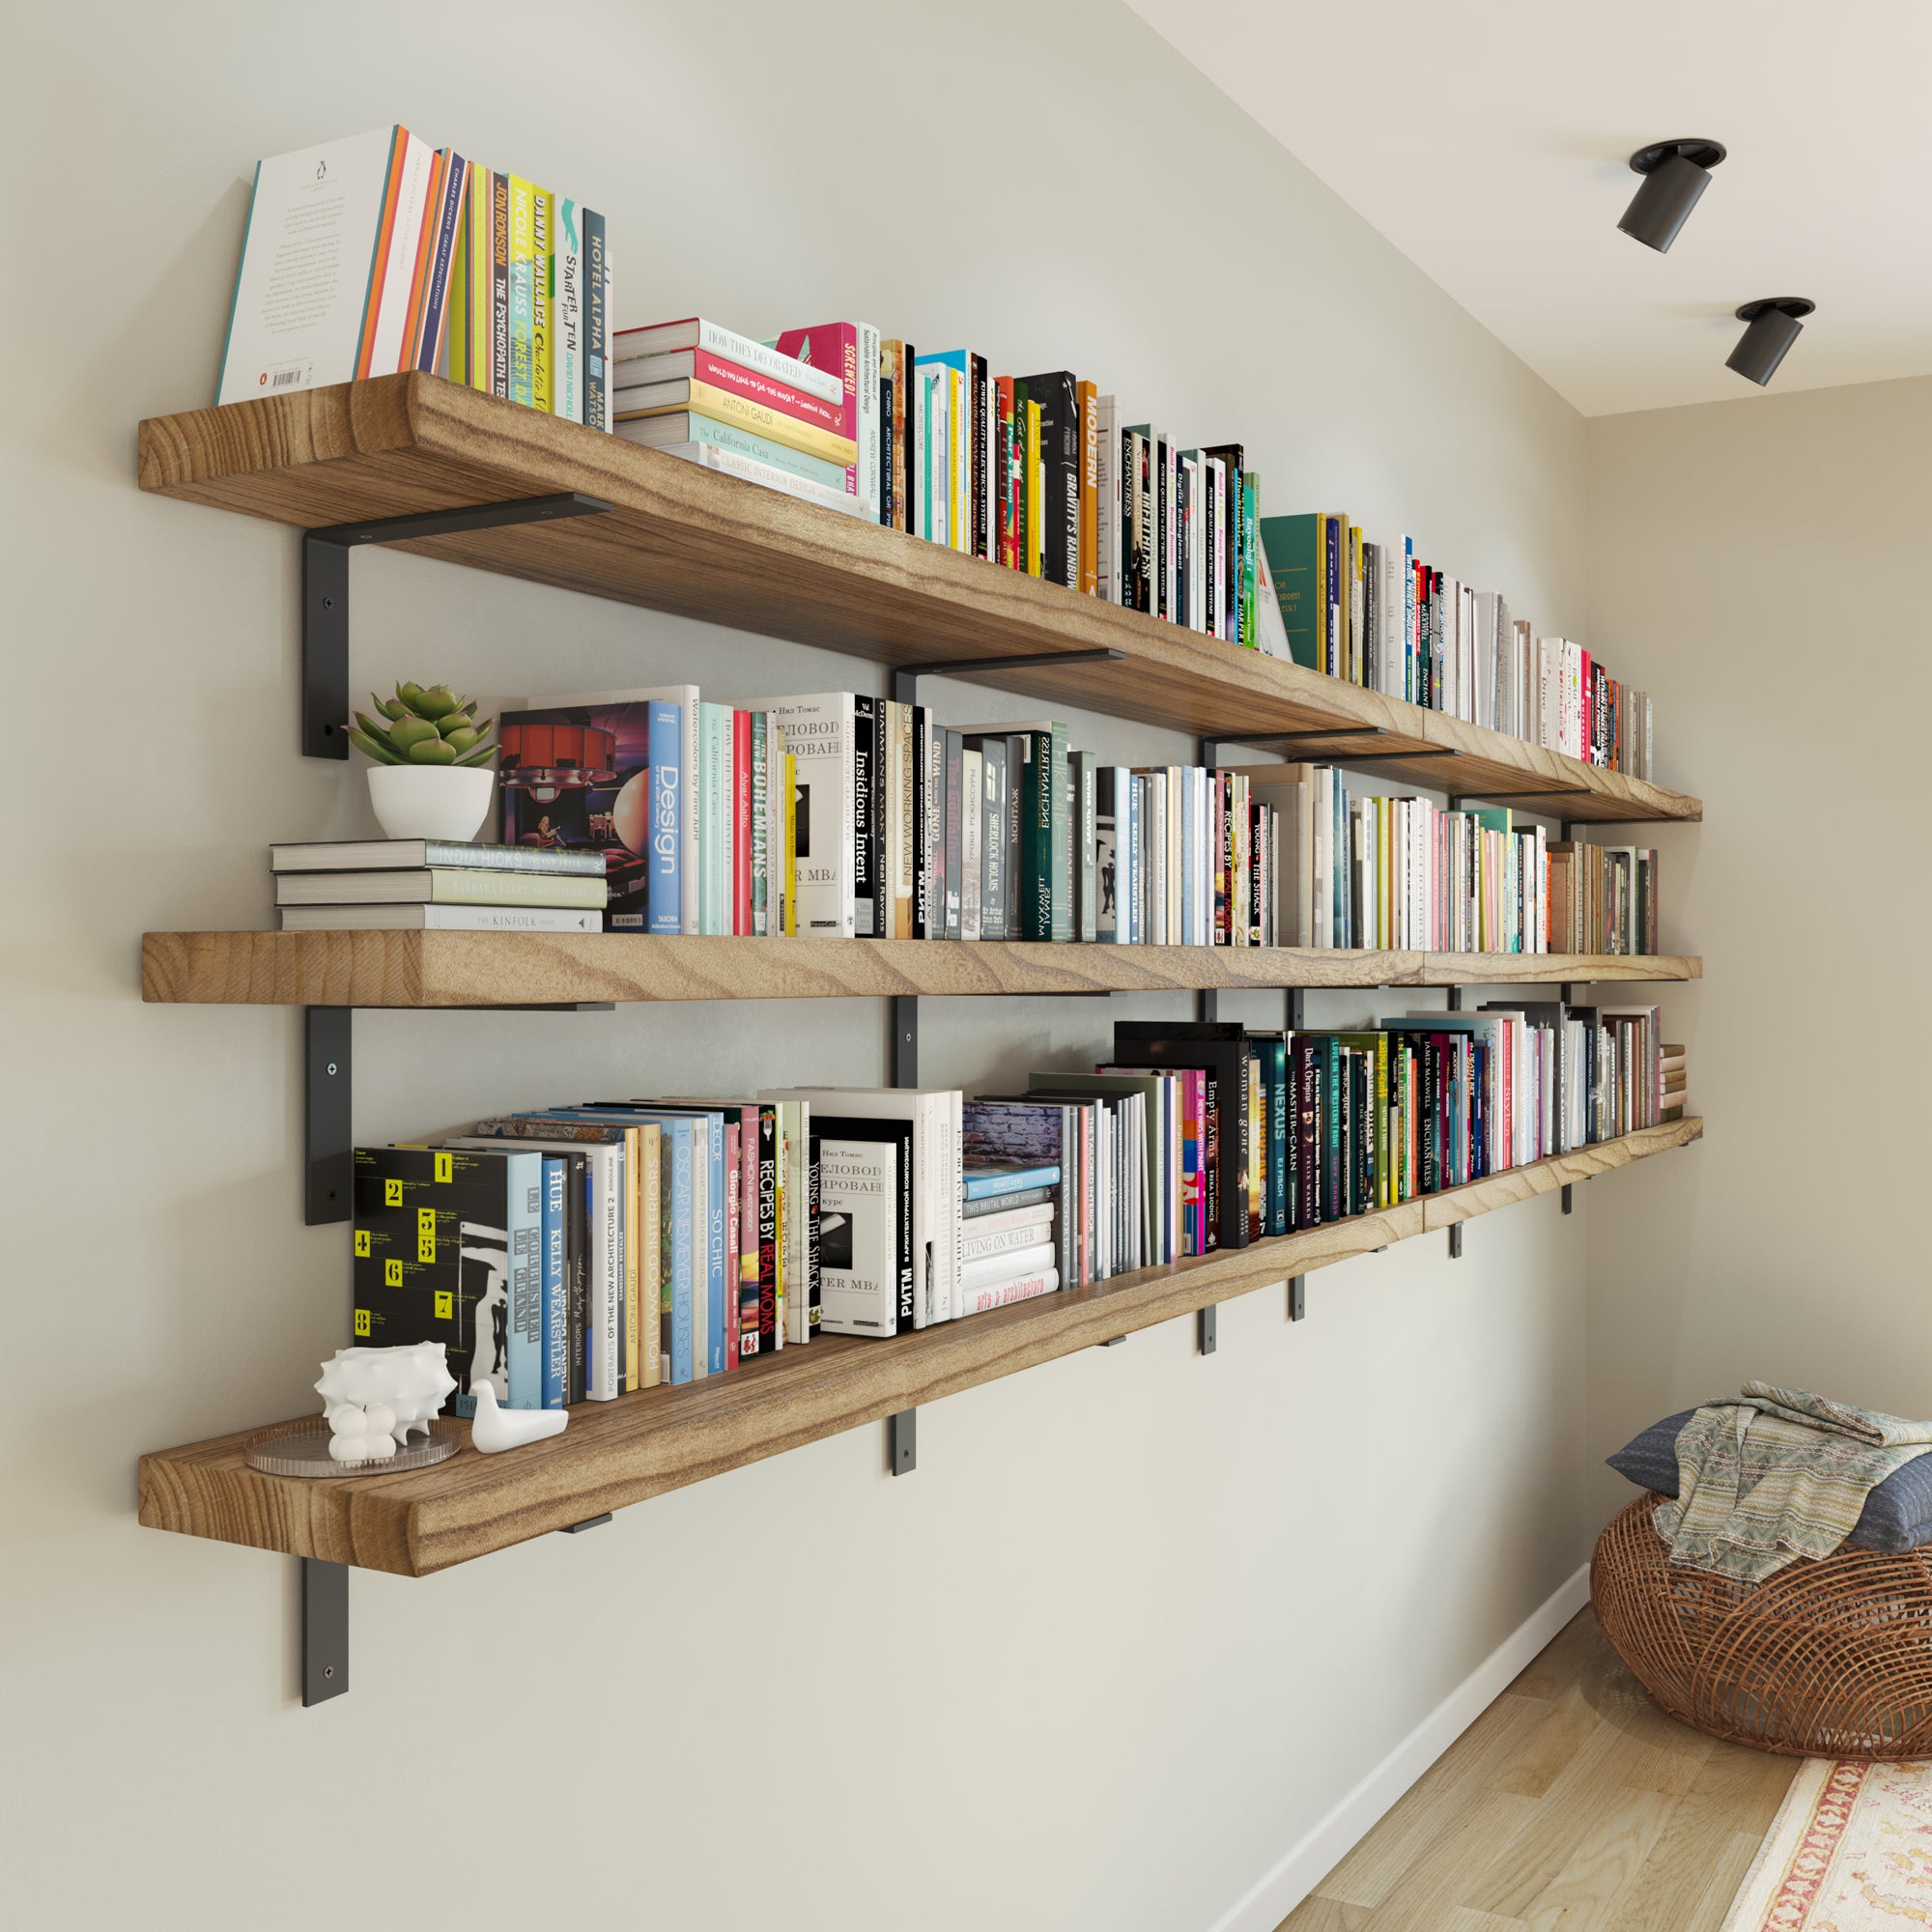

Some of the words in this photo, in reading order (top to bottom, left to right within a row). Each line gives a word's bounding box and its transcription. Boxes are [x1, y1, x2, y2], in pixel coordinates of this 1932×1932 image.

[451, 167, 460, 198] CHARLES
[495, 182, 507, 211] JON
[445, 199, 456, 230] DICKENS
[515, 188, 526, 247] NICOLE
[533, 195, 546, 251] DANNY
[440, 233, 449, 258] GREAT
[495, 211, 507, 267] RONSON
[592, 236, 602, 288] HOTEL
[433, 258, 444, 310] EXPECTATIONS
[497, 278, 507, 300] THE
[515, 251, 526, 317] KRAUSS
[533, 254, 546, 328] WALLACE
[564, 255, 578, 313] STARTER
[497, 301, 507, 379] PSYCHOPATH
[564, 322, 577, 351] TEN
[592, 294, 602, 350] ALPHA
[515, 320, 526, 382] FOREST
[533, 332, 546, 390] Charlotte
[708, 329, 727, 348] HOW
[730, 338, 752, 360] THEY
[753, 347, 802, 379] DECORATED
[723, 397, 749, 416] ANTONI
[713, 428, 751, 455] California
[752, 444, 769, 460] Casa
[1088, 396, 1097, 489] MODERN
[722, 454, 753, 475] CLASSIC
[753, 463, 789, 485] INTERIOR
[789, 474, 816, 496] DESIGN
[1066, 473, 1077, 534] GRAVITY'S
[1066, 535, 1077, 590] RAINBOW
[903, 705, 912, 762] SPACES
[692, 777, 699, 786] by
[856, 751, 868, 828] Insidious
[947, 759, 958, 785] The
[655, 766, 679, 874] Design
[754, 763, 766, 878] BOHEMIANS
[903, 768, 912, 838] WORKING
[1010, 788, 1019, 844] МОНТАЖ
[947, 790, 958, 866] Godfather
[989, 813, 999, 859] SHERLOCK
[440, 848, 476, 864] INDIA
[483, 851, 522, 867] HICKS
[856, 833, 868, 883] Intent
[903, 842, 912, 876] NEW
[989, 862, 999, 892] HOLMS
[1225, 855, 1232, 868] BY
[493, 916, 537, 927] KINFOLK
[1302, 1047, 1314, 1068] Dark
[1378, 1039, 1387, 1070] Potter
[1207, 1082, 1216, 1121] Empty
[1302, 1071, 1314, 1103] Origins
[1275, 1083, 1285, 1140] NEXUS
[713, 1123, 723, 1162] DECOR
[1238, 1119, 1248, 1154] gone
[440, 1158, 447, 1178] 1
[676, 1146, 690, 1207] OSCAR
[809, 1162, 820, 1205] YOUNG
[1277, 1157, 1284, 1168] EJ
[388, 1183, 399, 1201] 2
[528, 1188, 539, 1213] LE
[551, 1169, 562, 1212] HUE
[647, 1159, 659, 1250] INTERIORS
[728, 1170, 738, 1214] Giorgio
[760, 1161, 773, 1217] RECIPES
[967, 1202, 980, 1214] THIS
[980, 1199, 999, 1211] BRUTAL
[1000, 1194, 1019, 1208] WORLD
[421, 1211, 432, 1231] 3
[712, 1209, 723, 1233] SO
[728, 1218, 738, 1254] Casali
[760, 1222, 773, 1239] BY
[809, 1217, 820, 1242] THE
[357, 1233, 368, 1253] 4
[421, 1238, 433, 1258] 5
[514, 1230, 526, 1255] LE
[551, 1230, 562, 1278] KELLY
[676, 1208, 690, 1290] NIEMEYER
[712, 1236, 723, 1278] CHIC
[760, 1244, 773, 1283] REAL
[962, 1239, 993, 1257] LIVING
[995, 1236, 1006, 1250] ON
[1008, 1229, 1035, 1247] WATER
[388, 1262, 400, 1282] 6
[528, 1227, 539, 1343] CORBUSIER
[809, 1246, 820, 1289] SHACK
[439, 1294, 449, 1314] 7
[514, 1267, 526, 1333] GRAND
[647, 1256, 659, 1370] HOLLYWOOD
[760, 1285, 773, 1334] MOMS
[901, 1268, 913, 1317] РИТМ
[978, 1292, 992, 1311] arts
[1003, 1278, 1044, 1305] architecture
[357, 1312, 368, 1331] 8
[551, 1285, 562, 1378] WEARSTLER
[676, 1293, 690, 1359] HOUSES
